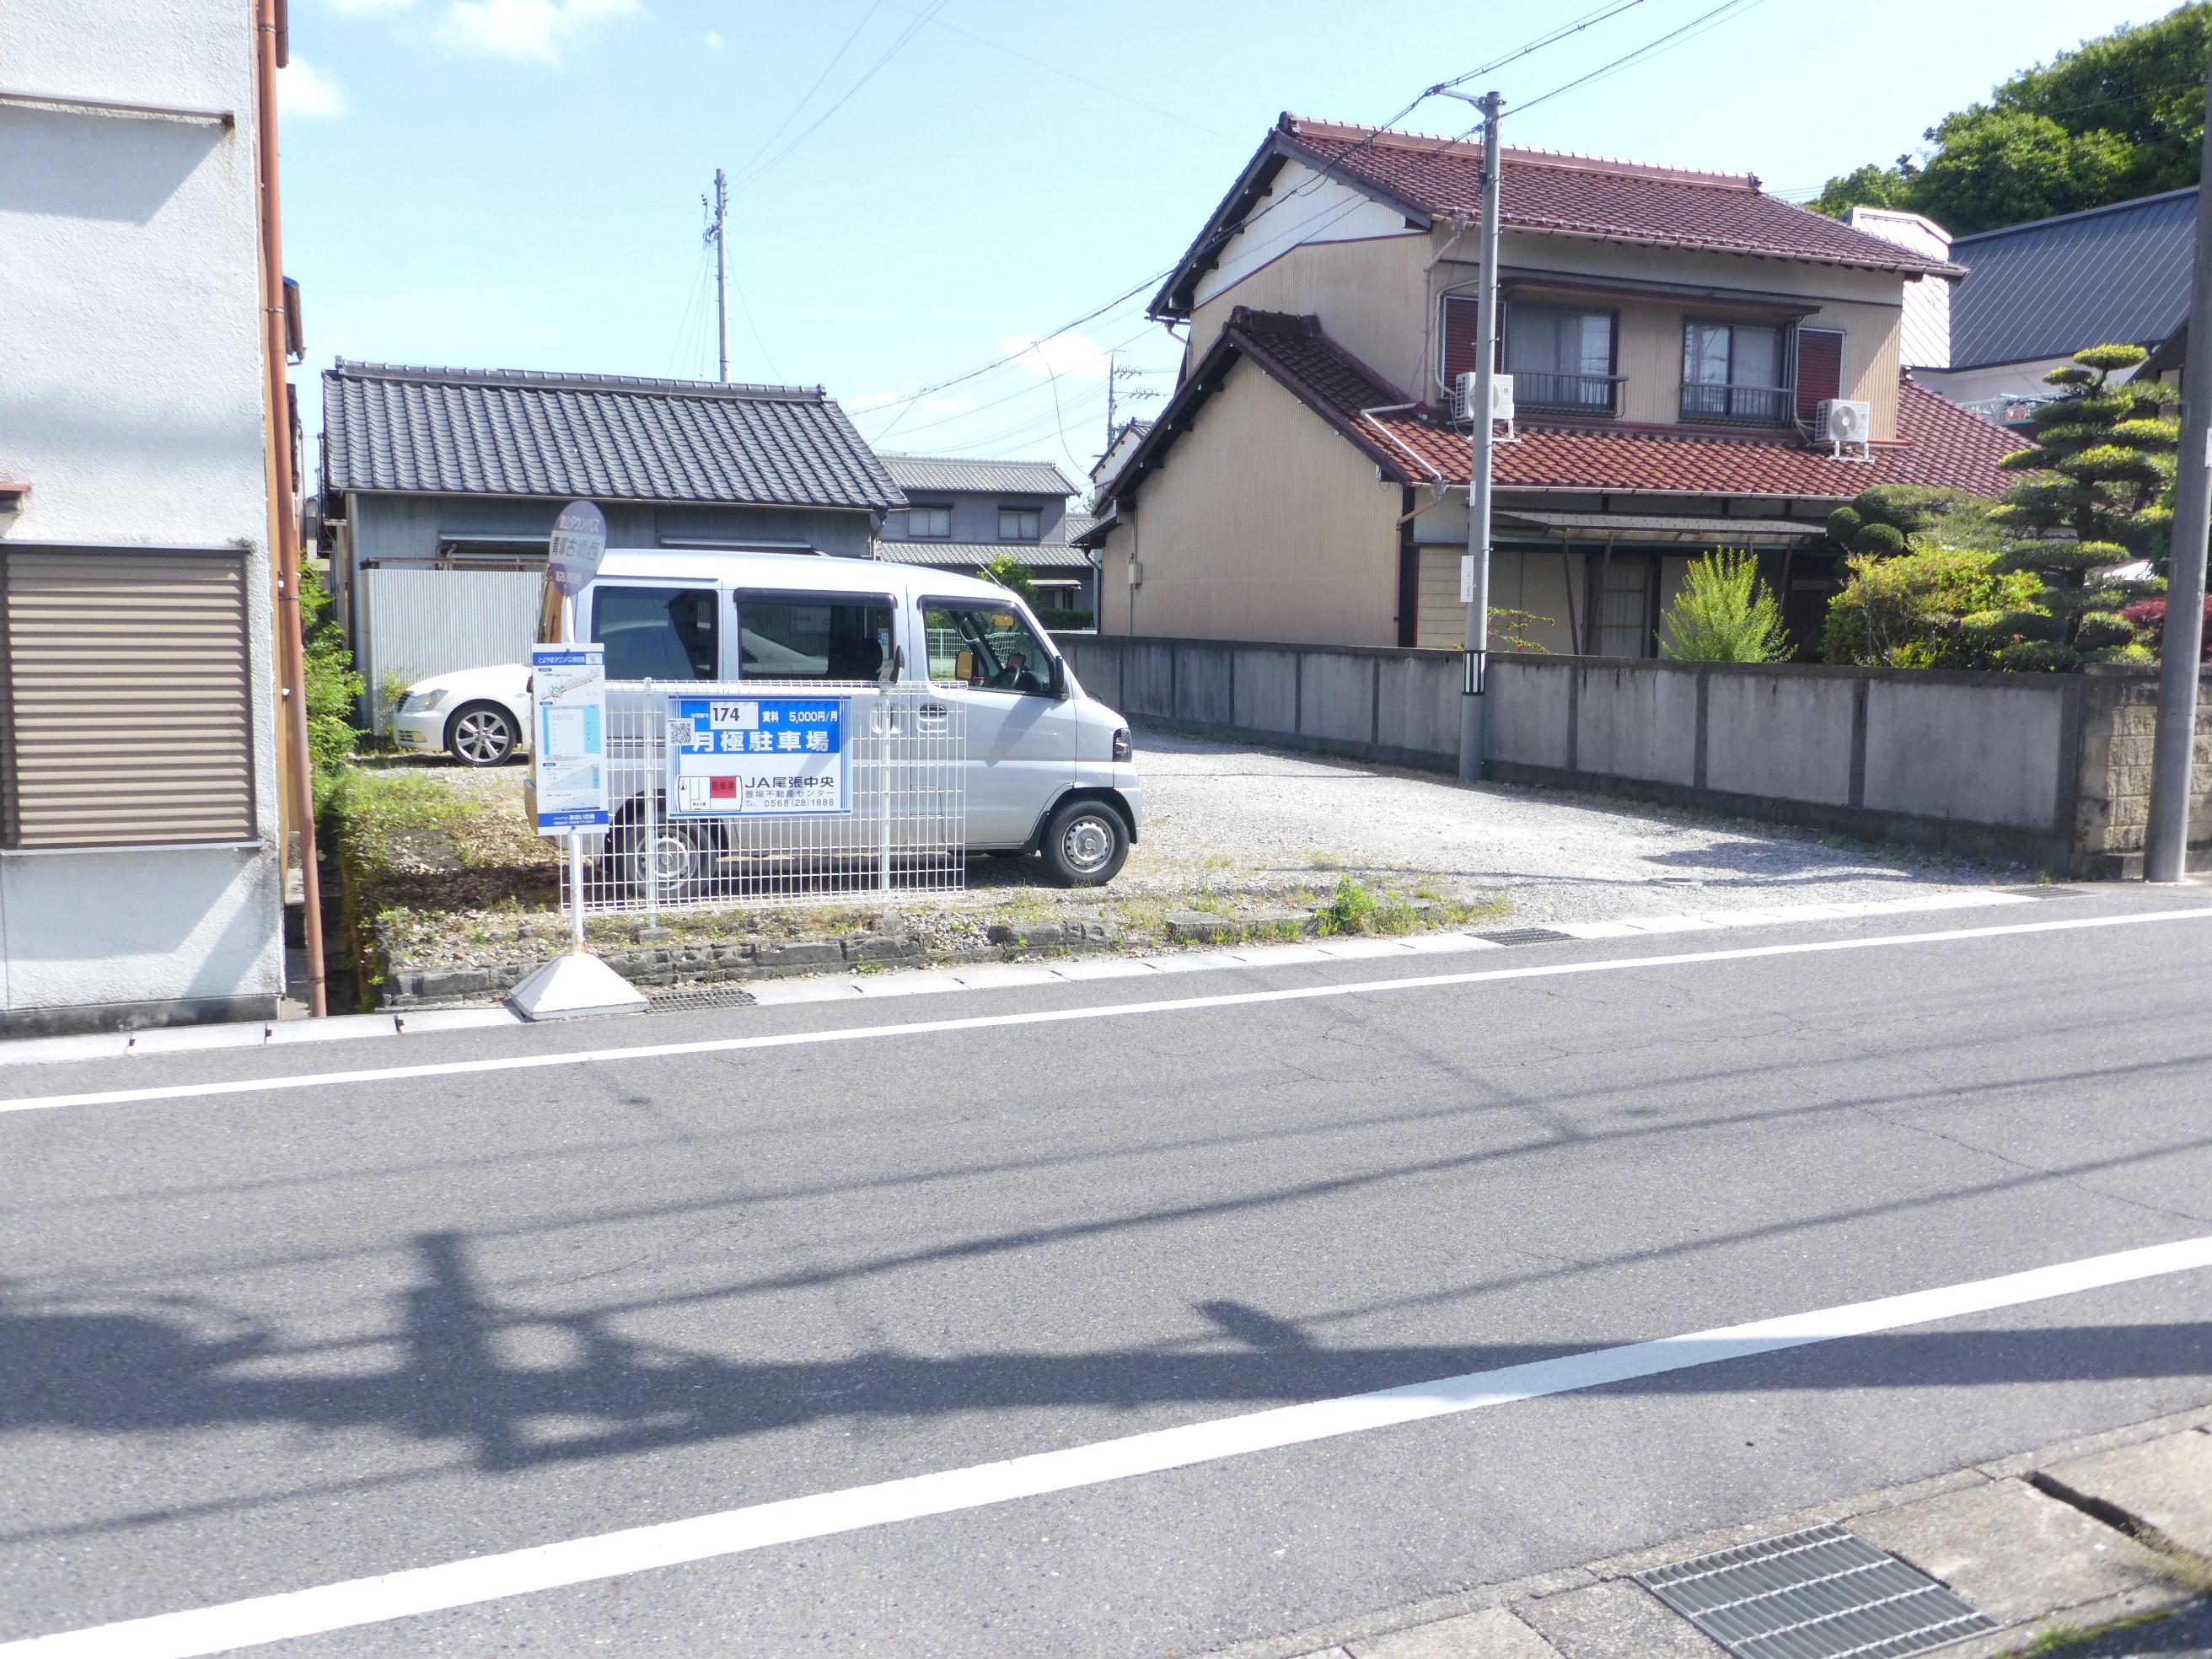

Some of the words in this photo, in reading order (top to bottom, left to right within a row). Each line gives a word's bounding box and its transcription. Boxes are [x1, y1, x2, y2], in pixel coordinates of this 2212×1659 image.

[712, 707, 740, 722] 174
[762, 711, 780, 722] 賃料
[789, 711, 838, 723] 5,000円/月
[691, 730, 830, 752] 月極駐車場
[744, 776, 835, 788] JA尾張中央
[745, 790, 835, 798] 豊場不動産センター
[764, 798, 835, 808] 0568(28)1888
